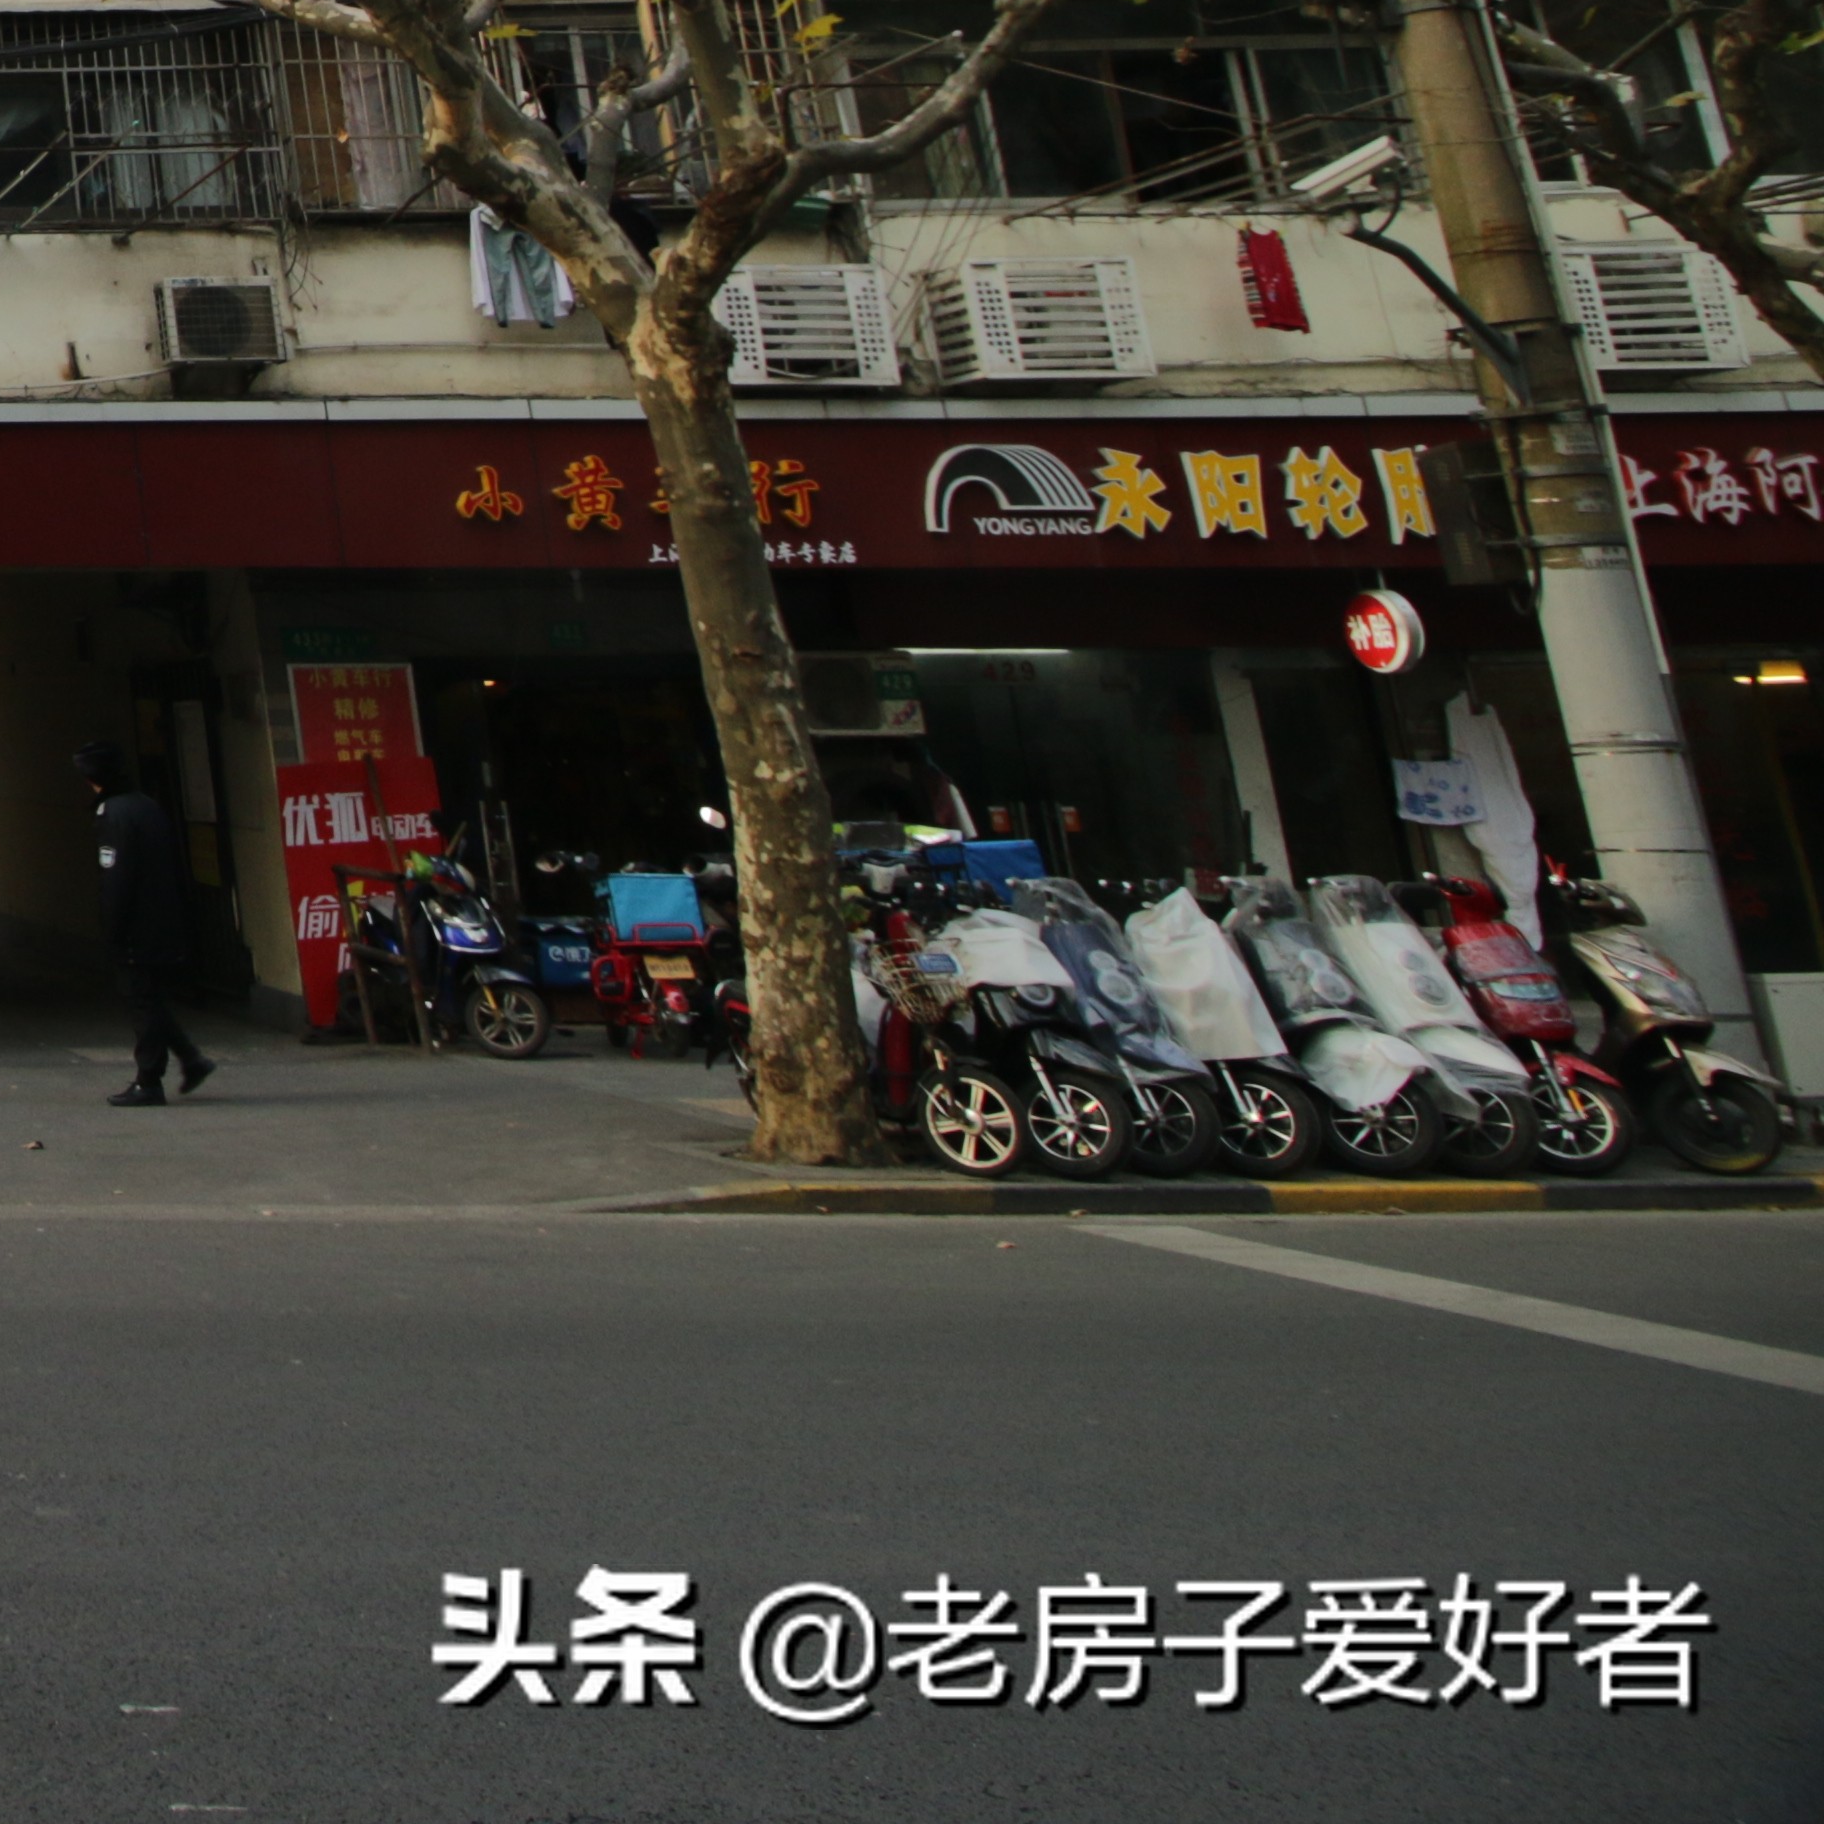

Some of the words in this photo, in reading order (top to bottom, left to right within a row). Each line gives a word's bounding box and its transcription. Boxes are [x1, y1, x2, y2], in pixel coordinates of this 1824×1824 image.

[454, 454, 822, 532] 小黄行
[974, 517, 1093, 536] YONGYANG
